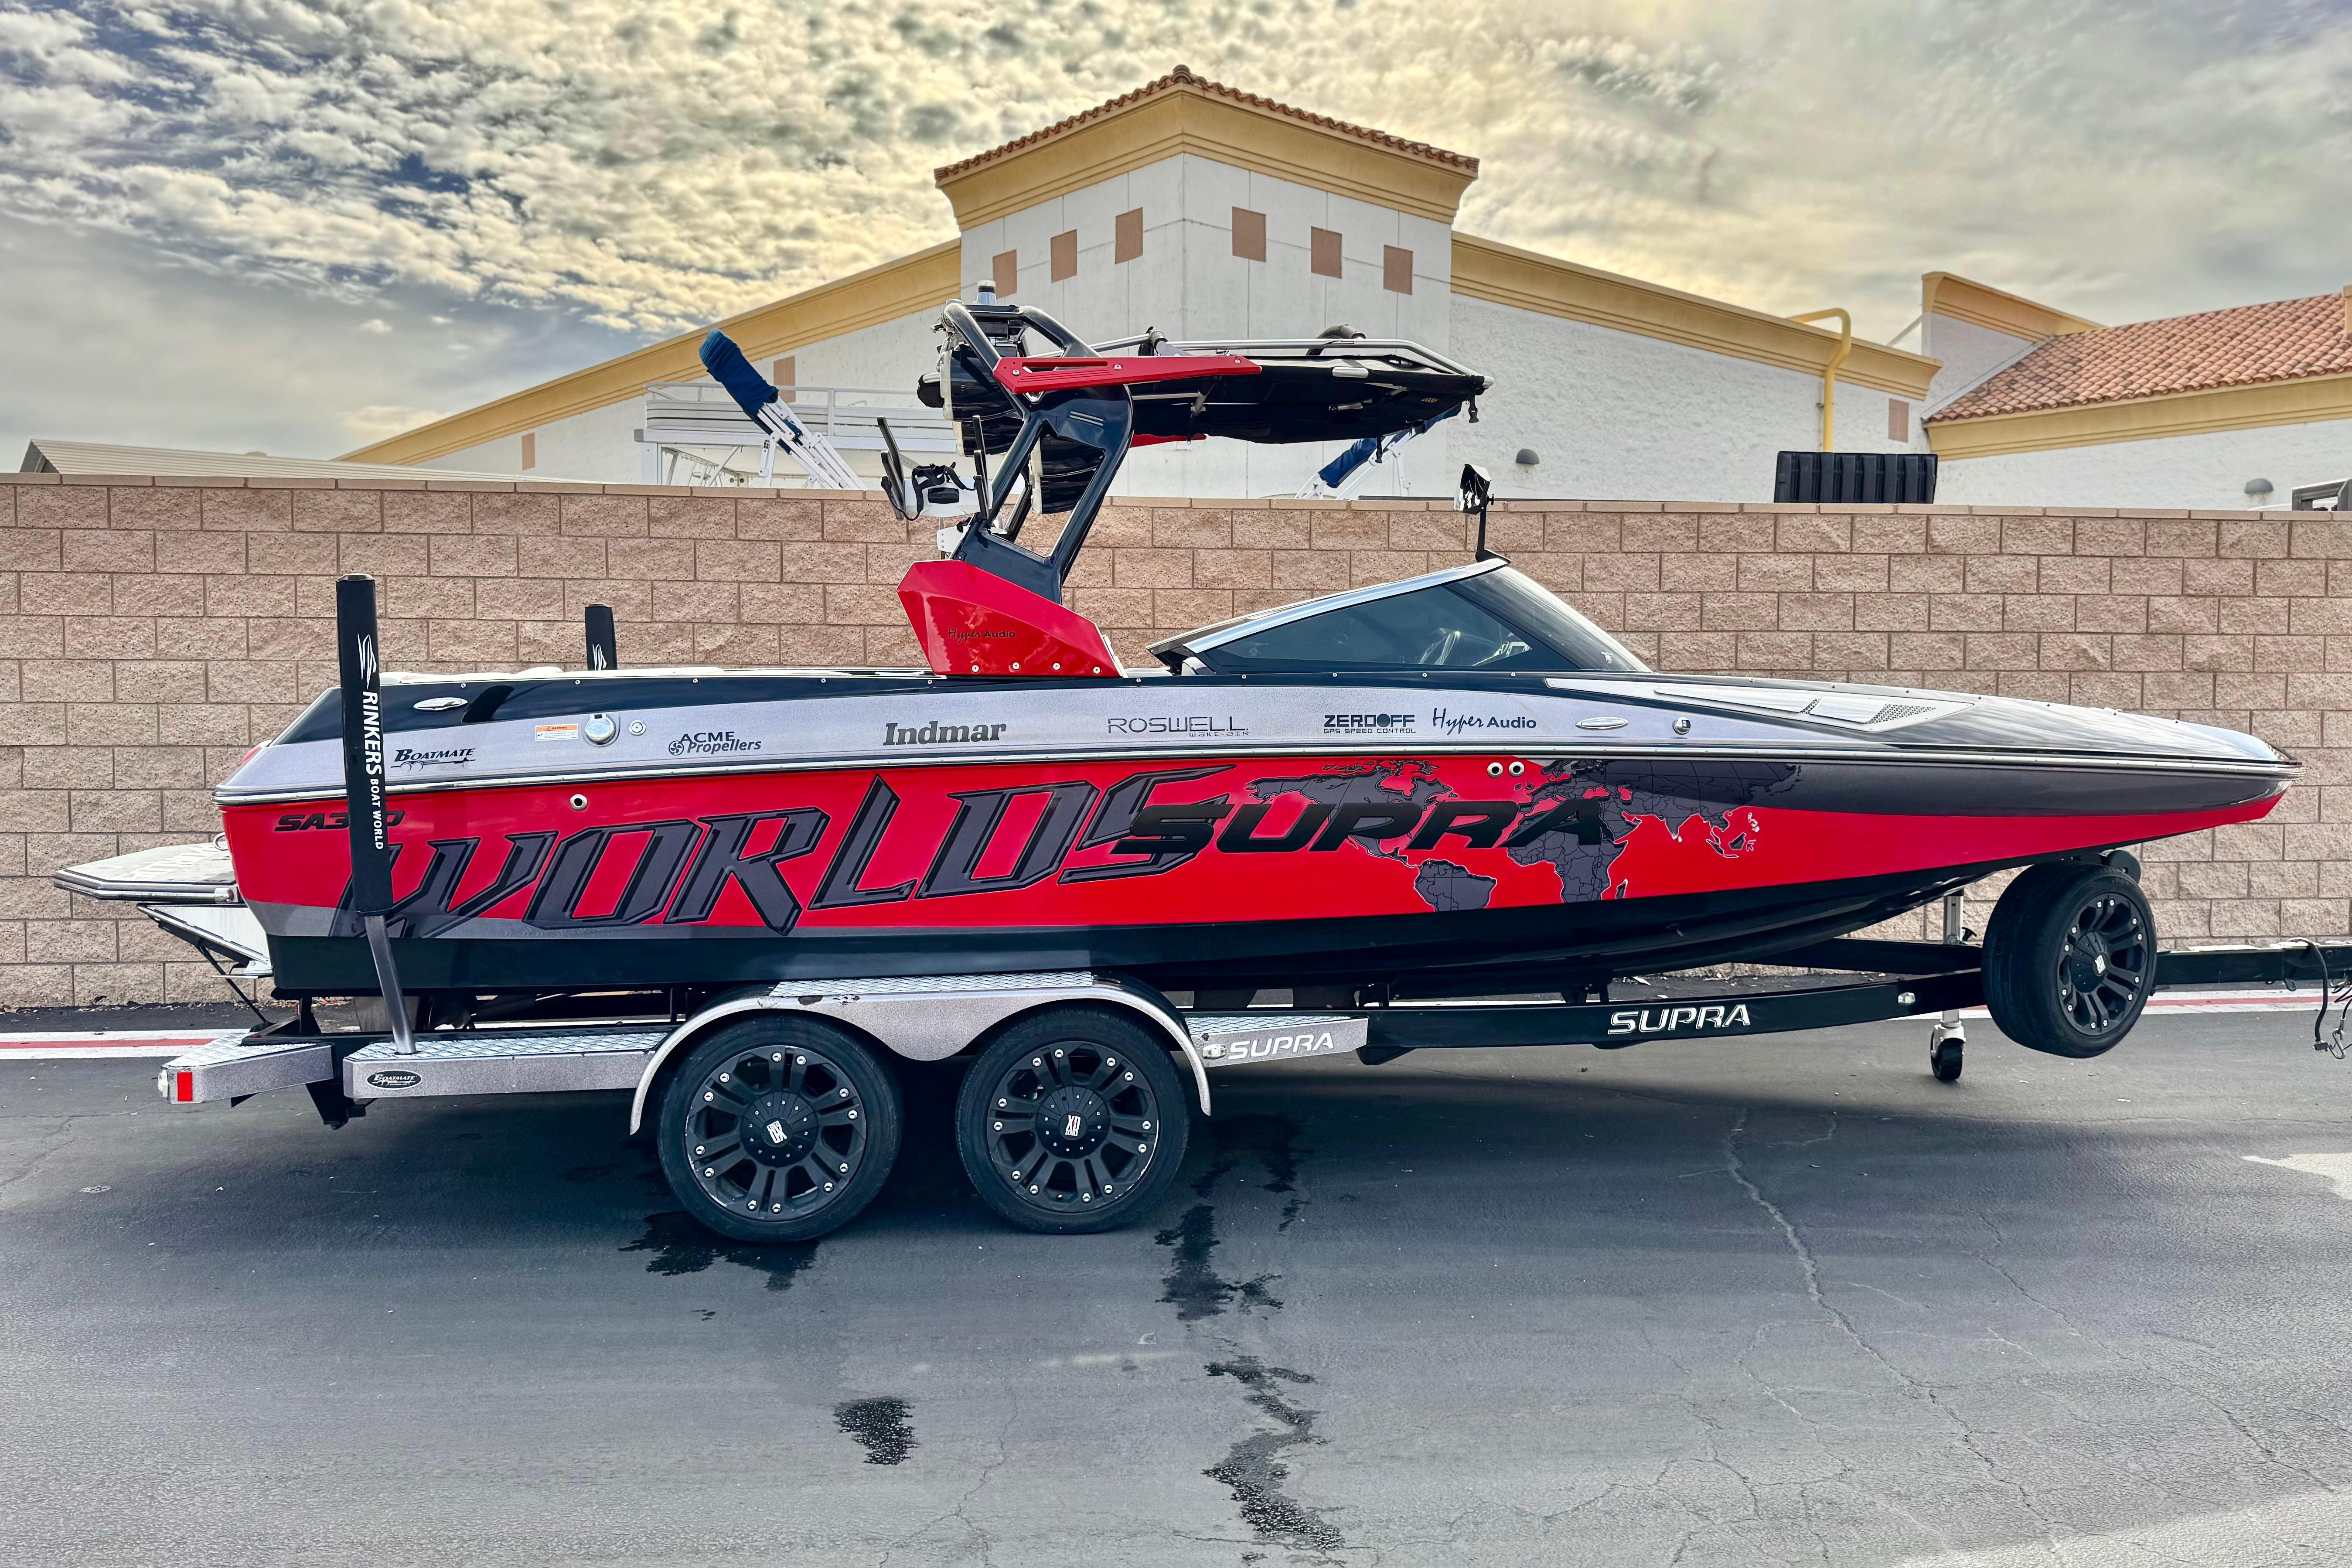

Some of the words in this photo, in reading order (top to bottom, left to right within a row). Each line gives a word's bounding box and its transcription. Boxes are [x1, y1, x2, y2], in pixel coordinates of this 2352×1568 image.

[948, 627, 981, 644] Hyper
[363, 691, 382, 776] RINKERS
[883, 721, 1007, 746] Indmar
[1108, 716, 1249, 733] ROSWELL
[1433, 708, 1484, 735] Hyper
[1487, 717, 1536, 728] Audio
[680, 731, 735, 743] ACME
[687, 739, 762, 754] Propellers
[394, 748, 476, 762] BOATMATE
[370, 778, 381, 808] BOAT
[274, 810, 405, 832] SA30
[373, 810, 384, 850] WORLD
[1110, 798, 1603, 854] SUPRA
[1608, 1004, 1750, 1035] SUPRA
[1227, 1032, 1334, 1060] SUPRA
